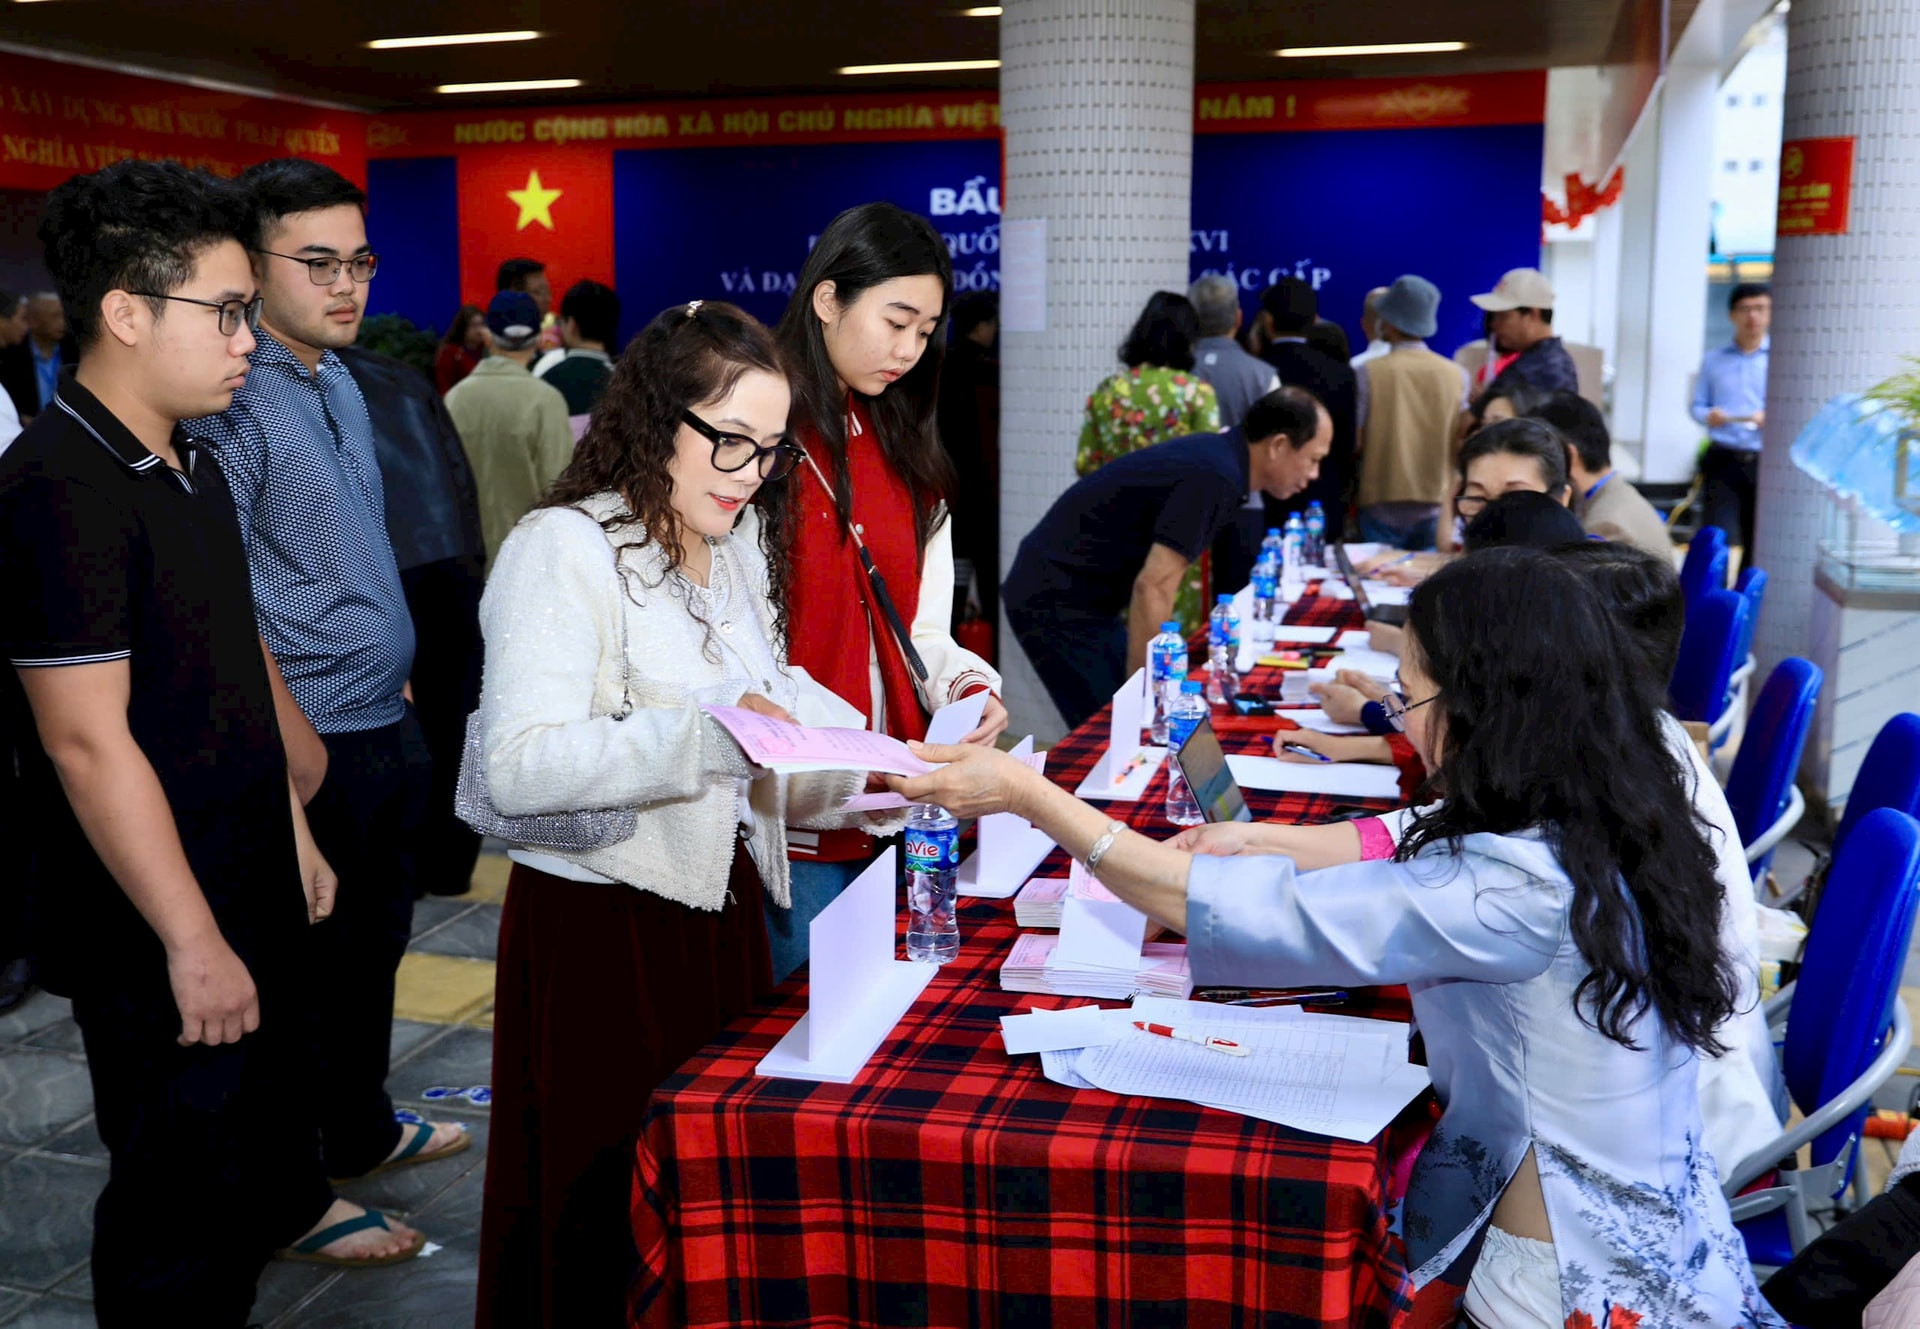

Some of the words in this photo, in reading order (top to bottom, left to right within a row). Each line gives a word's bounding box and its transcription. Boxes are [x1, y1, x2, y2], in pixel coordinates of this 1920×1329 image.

[534, 114, 608, 145] CỘNG
[722, 107, 770, 138] HỘI
[777, 102, 836, 133] CHỦ
[941, 224, 1000, 259] QUỐ
[906, 839, 939, 856] aVie
